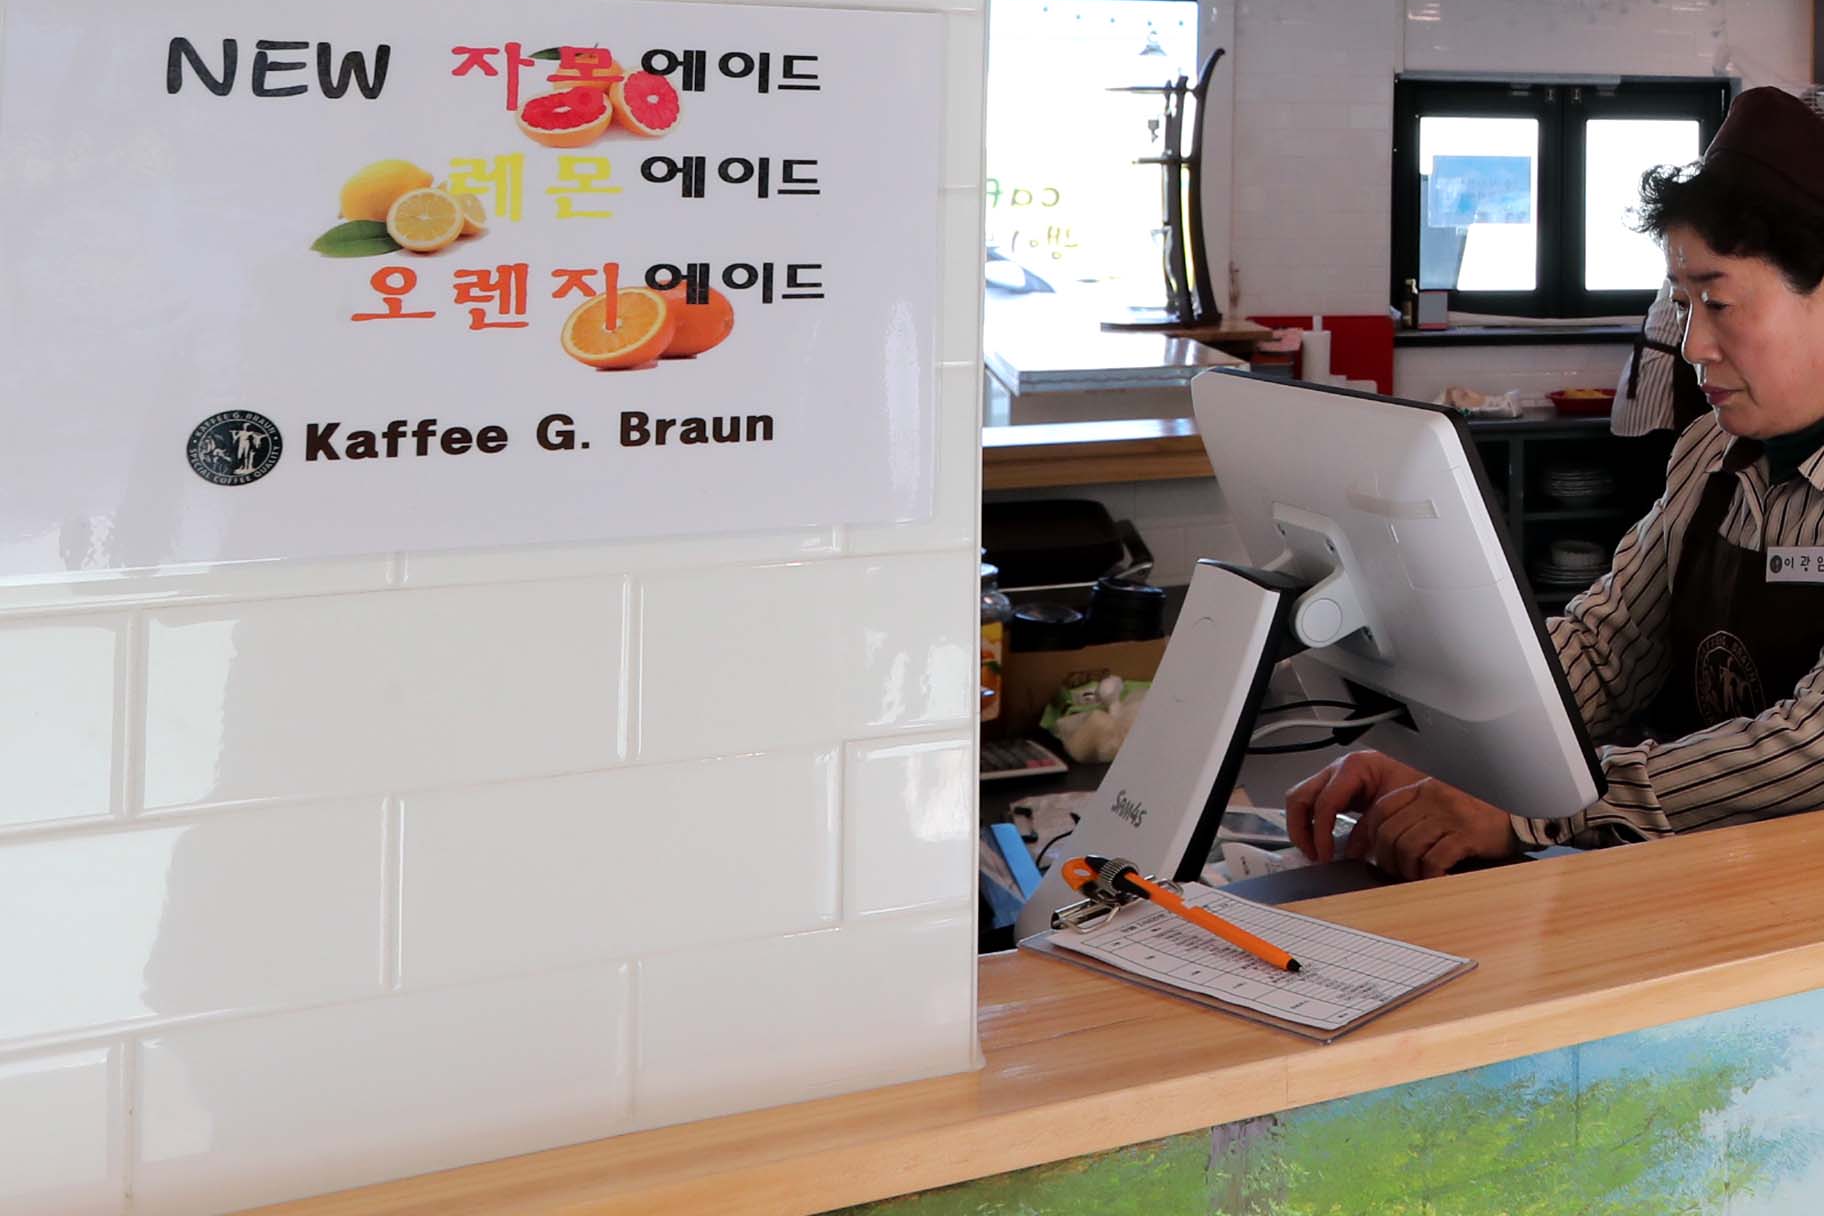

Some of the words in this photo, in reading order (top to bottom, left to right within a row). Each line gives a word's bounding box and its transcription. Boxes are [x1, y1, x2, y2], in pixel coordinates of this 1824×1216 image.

[166, 36, 391, 100] NEW
[305, 418, 509, 461] Kaffee
[535, 416, 591, 453] G.
[621, 411, 774, 447] Braun
